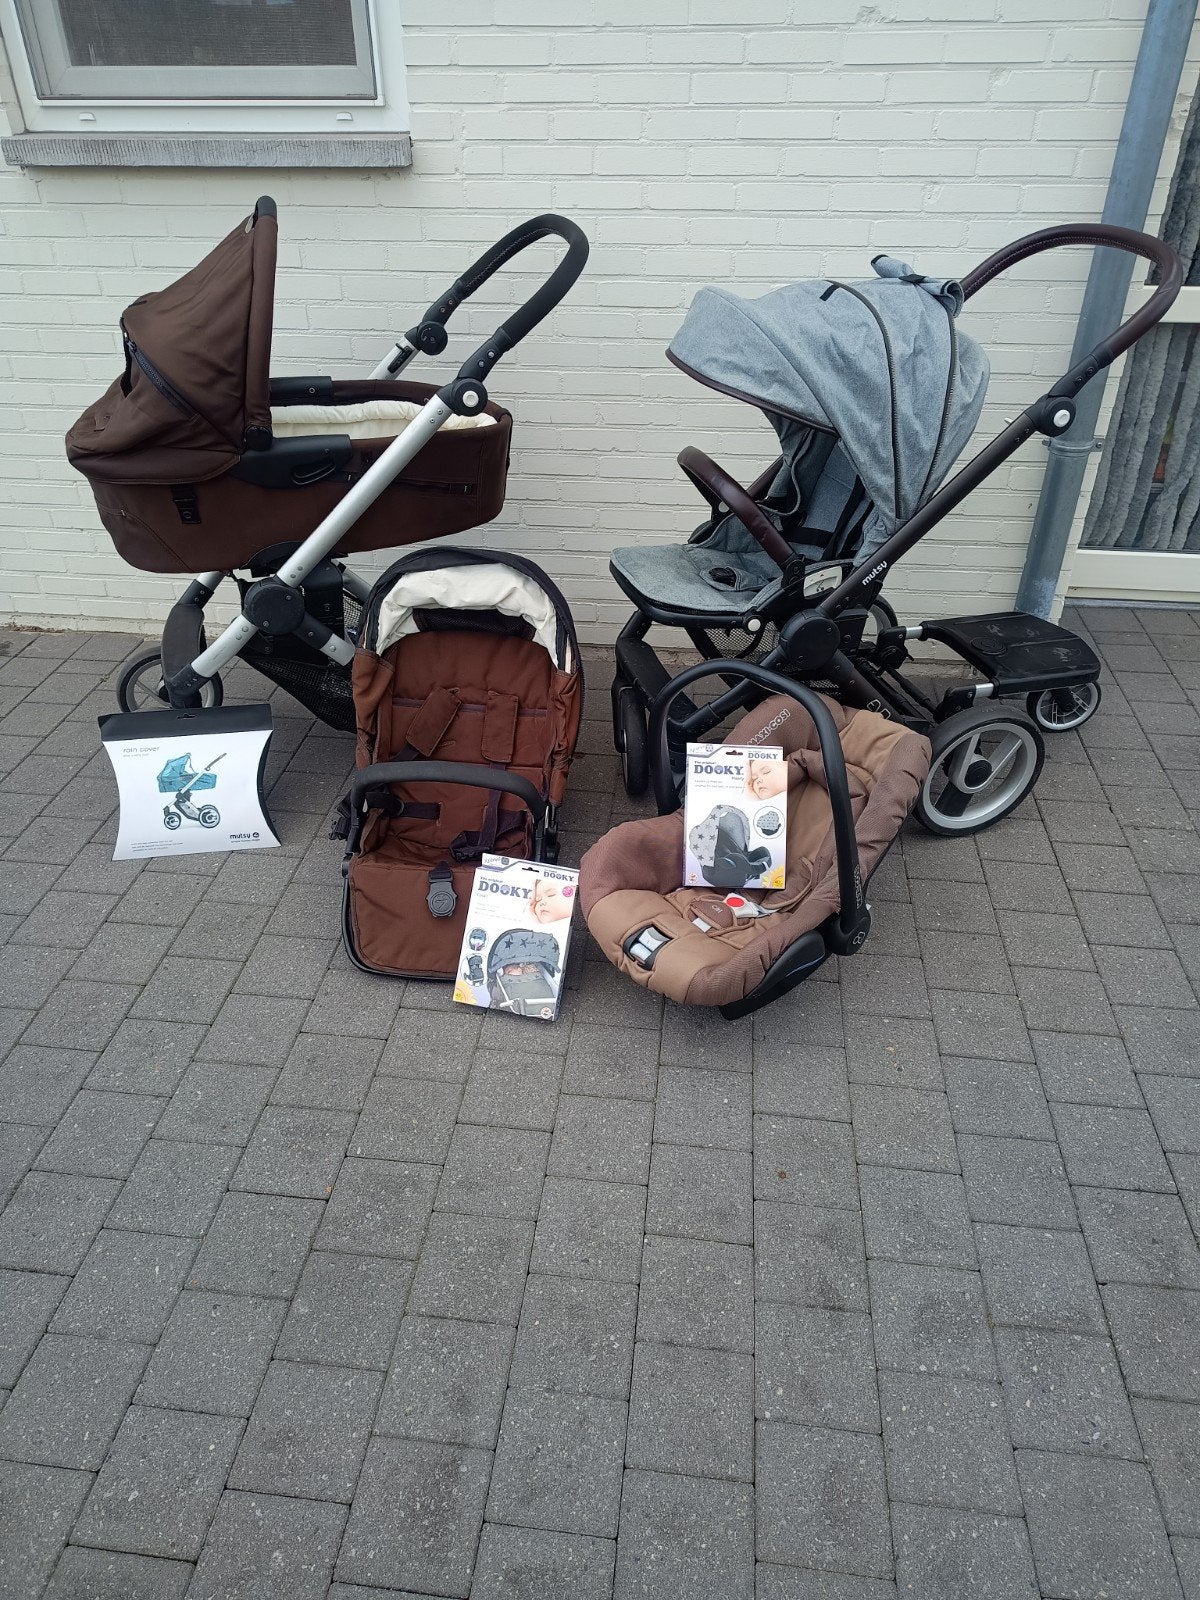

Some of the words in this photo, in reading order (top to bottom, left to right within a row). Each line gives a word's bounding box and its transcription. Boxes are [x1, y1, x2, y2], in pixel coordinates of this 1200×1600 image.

[862, 560, 887, 586] mutsy
[748, 752, 778, 760] DOOKY
[694, 764, 743, 776] DOOKY
[229, 832, 251, 840] mutsy
[543, 871, 574, 882] DOOKY
[478, 880, 532, 899] DOOKY
